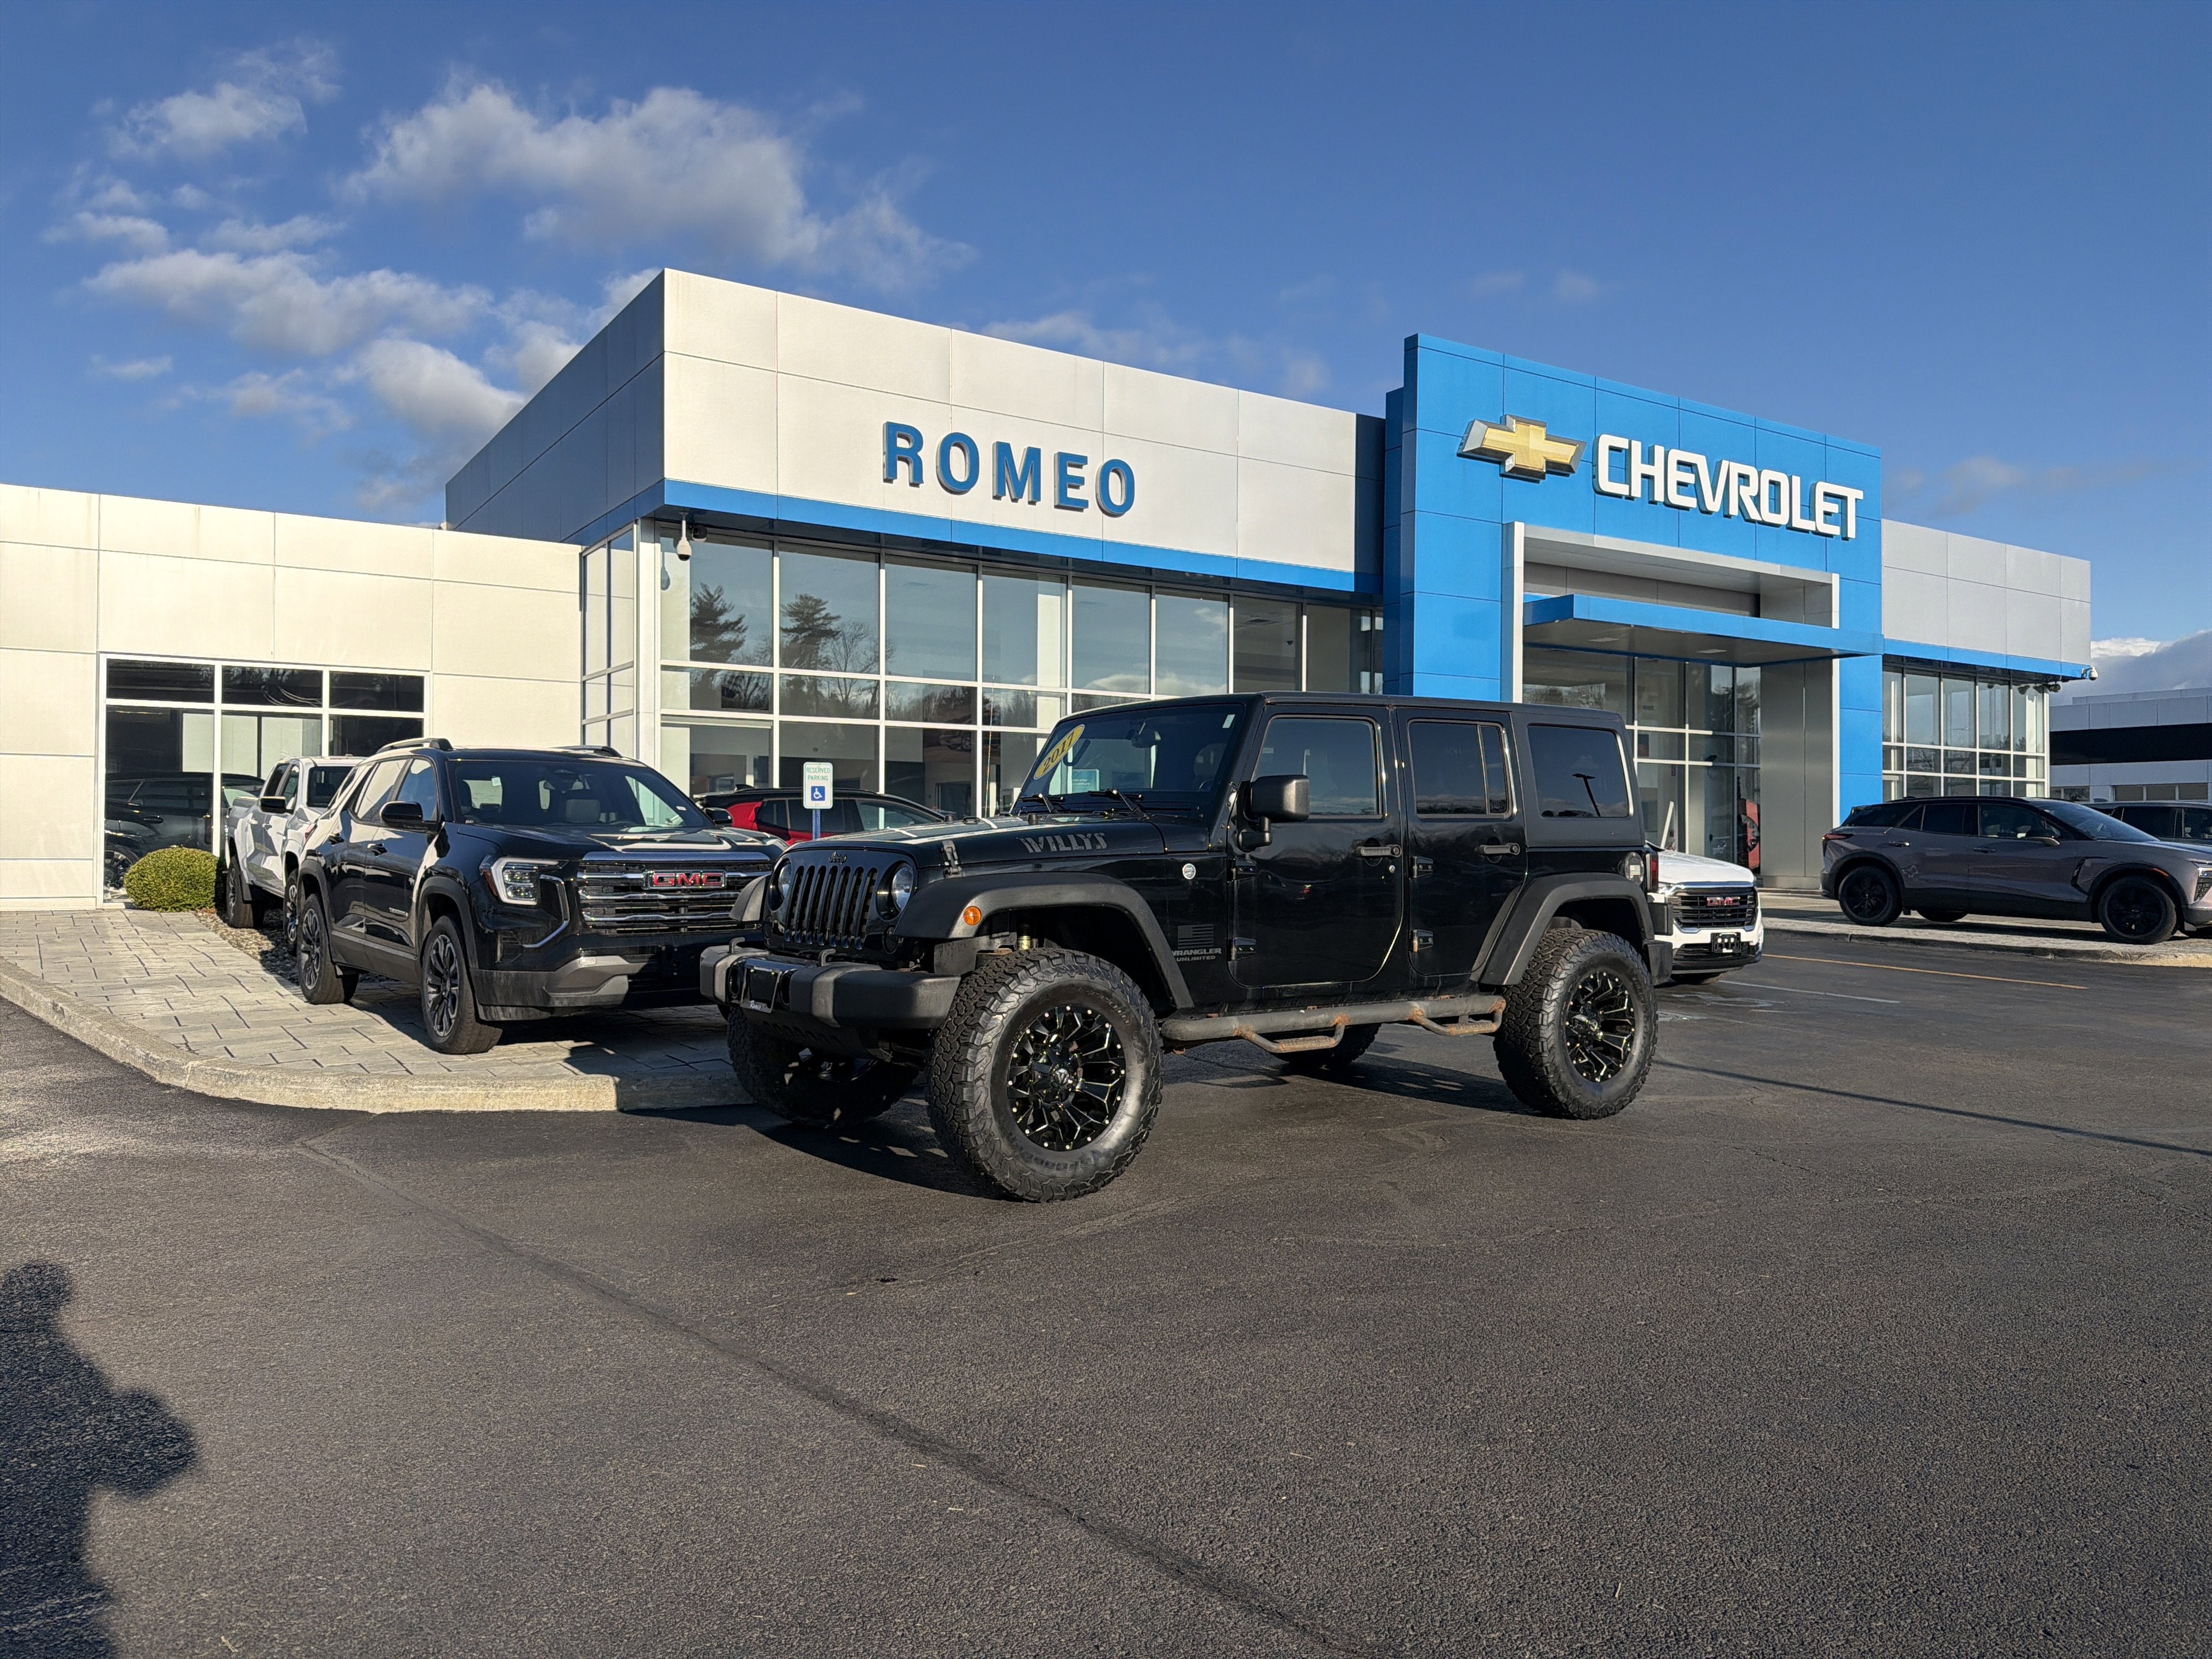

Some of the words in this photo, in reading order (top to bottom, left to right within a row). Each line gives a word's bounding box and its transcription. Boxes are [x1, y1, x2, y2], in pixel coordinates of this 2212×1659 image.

[882, 421, 1135, 517] ROMEO
[1595, 434, 1864, 539] CHEVROLET
[1042, 731, 1075, 774] 2017
[1018, 833, 1107, 853] WILLYS
[828, 851, 847, 865] Jeep
[653, 873, 723, 887] GMC
[1707, 897, 1740, 906] GMC
